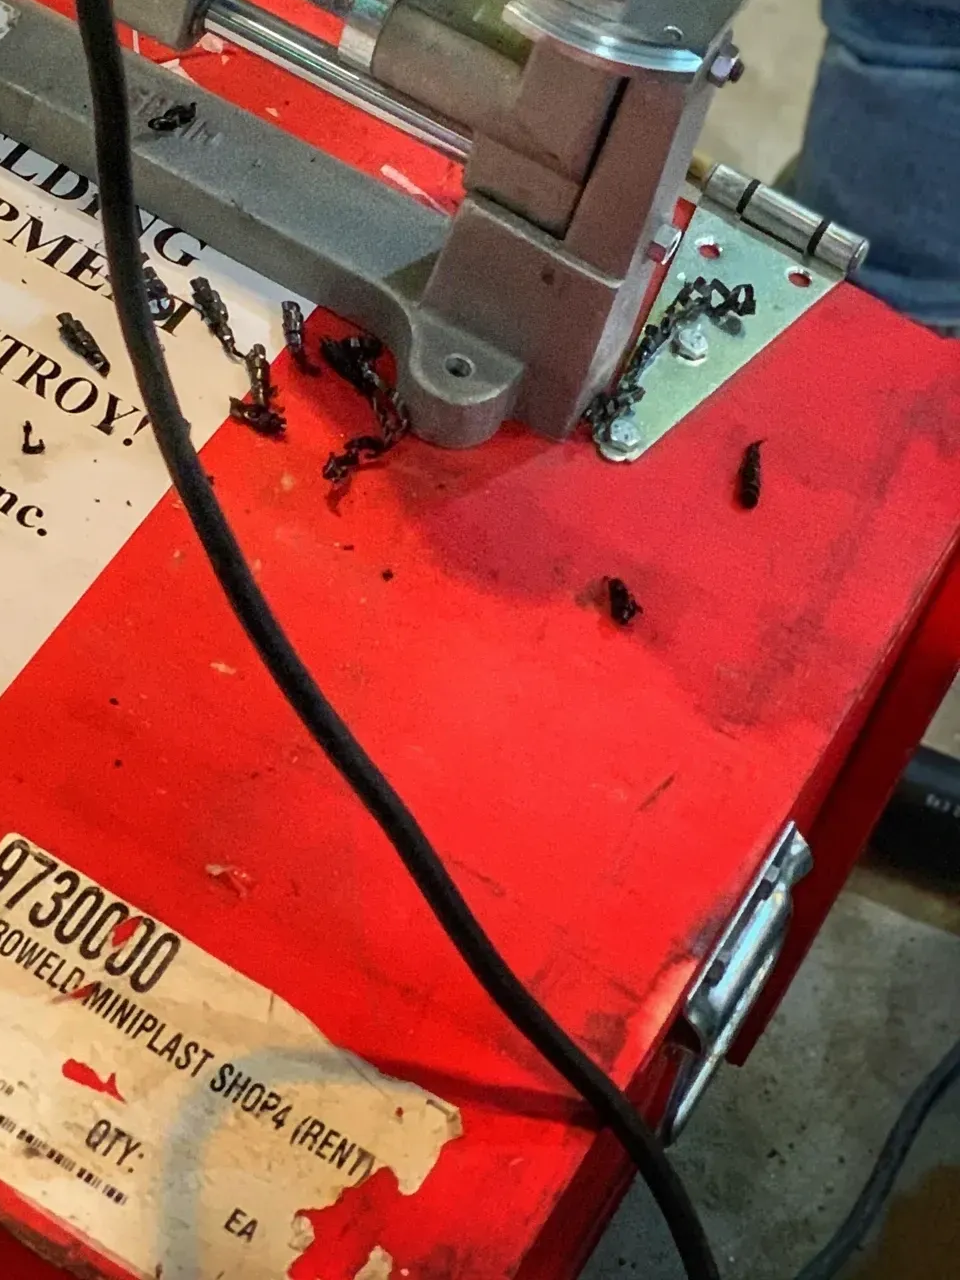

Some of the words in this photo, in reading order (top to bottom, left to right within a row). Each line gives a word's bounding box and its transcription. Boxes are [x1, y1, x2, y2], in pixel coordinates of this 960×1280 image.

[81, 980, 215, 1078] MINIPLAST
[209, 1062, 293, 1131] SHOP4
[85, 1119, 145, 1174] QTY:
[223, 1207, 259, 1243] EA
